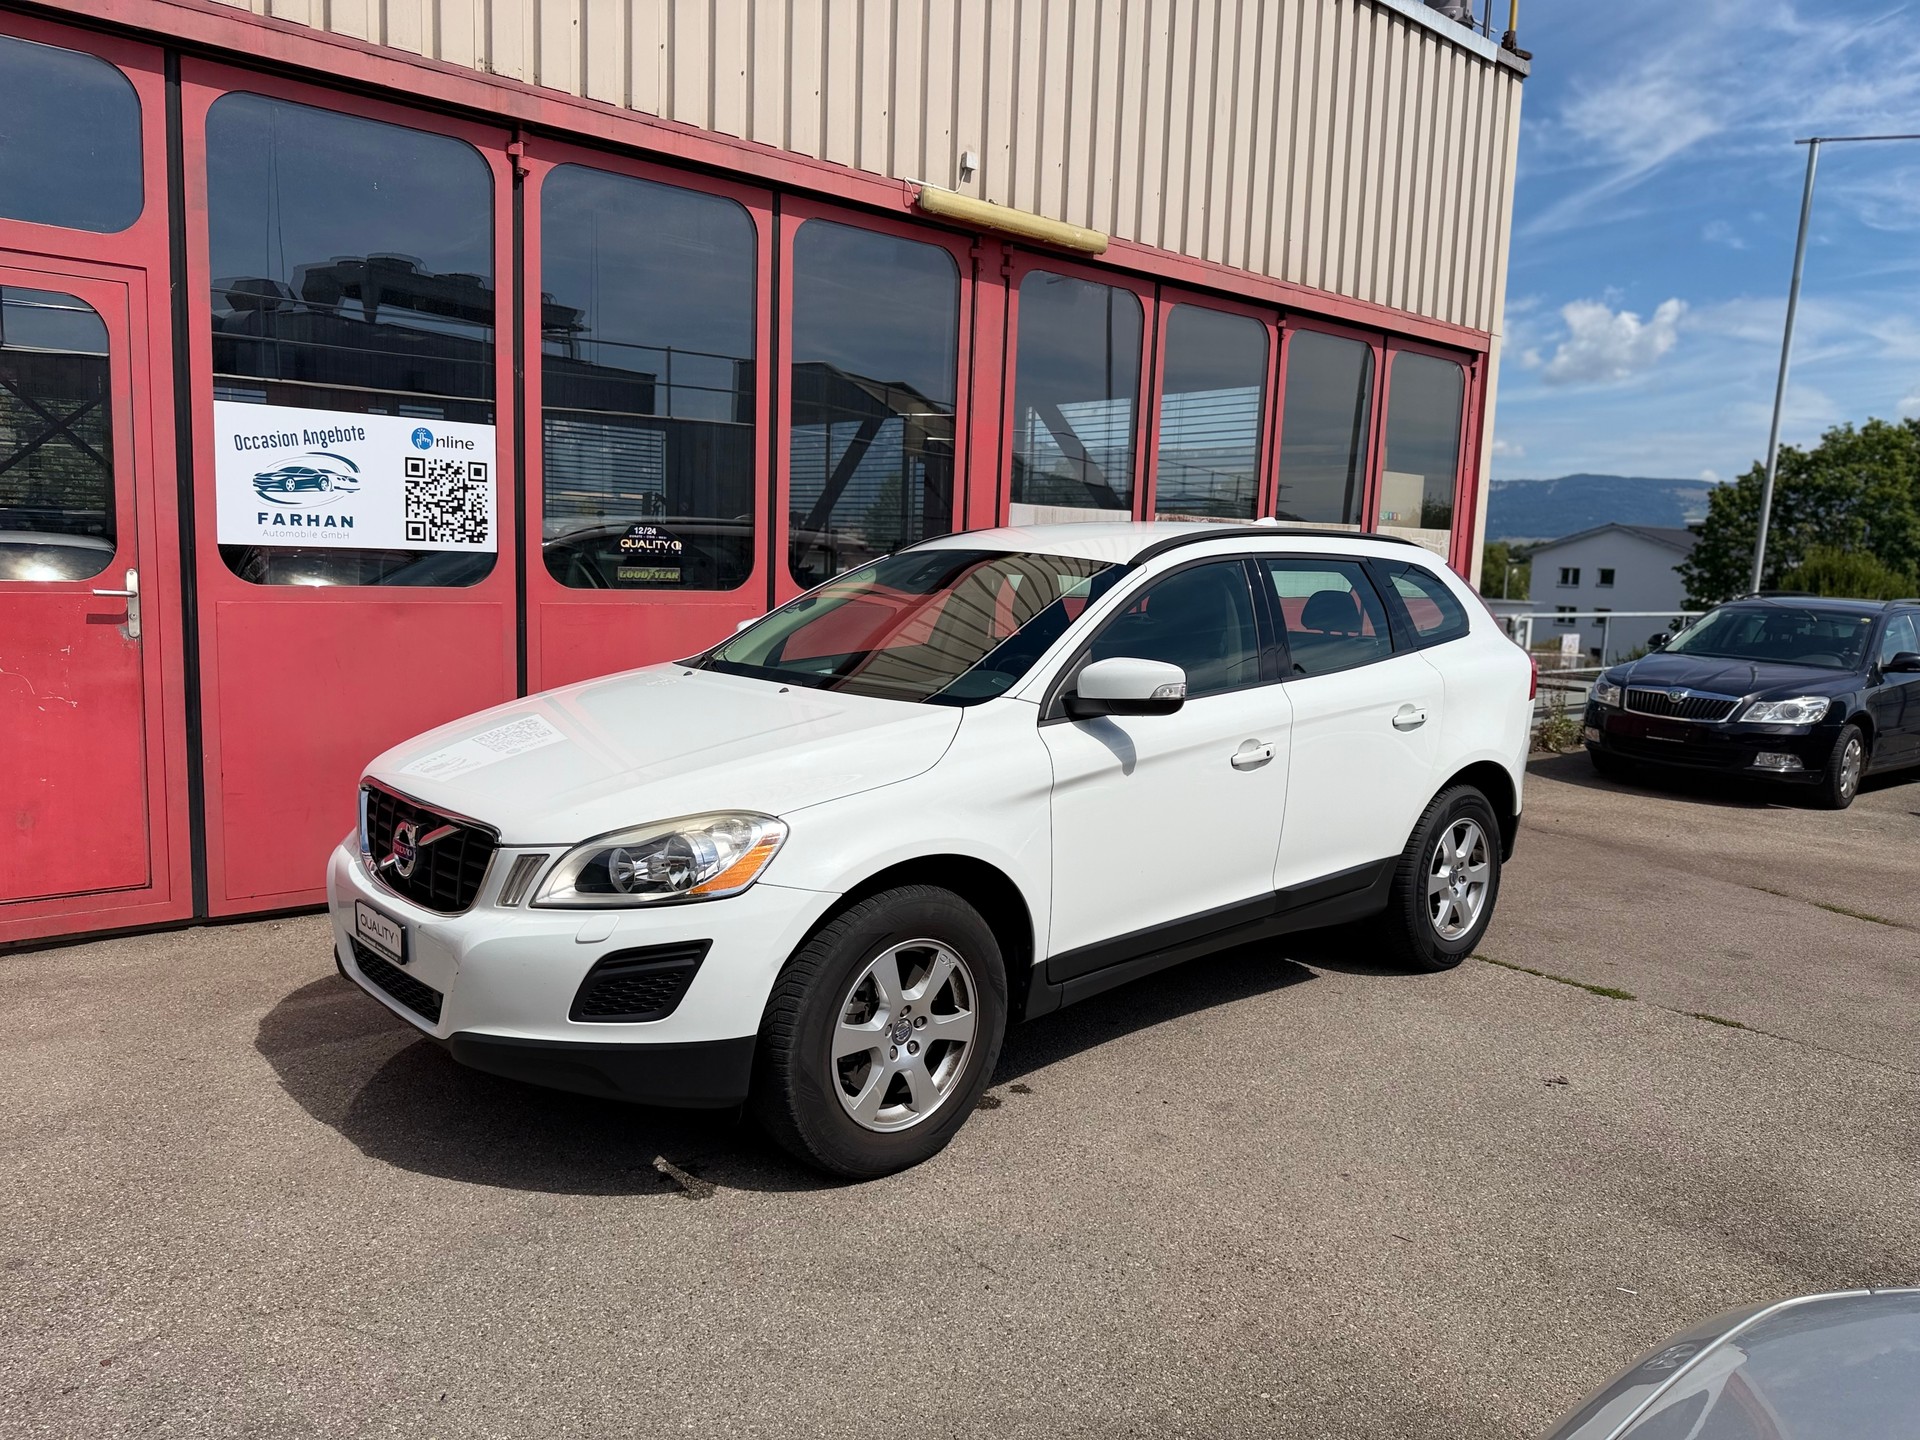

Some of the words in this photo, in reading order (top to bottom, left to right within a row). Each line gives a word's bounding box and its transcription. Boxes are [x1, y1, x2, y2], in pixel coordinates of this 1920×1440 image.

[234, 430, 299, 451] Occasion
[303, 425, 365, 449] Angebote
[257, 512, 354, 528] FARHAN
[262, 529, 318, 539] Automobile
[321, 531, 350, 540] GmbH
[634, 526, 657, 535] 12/24
[619, 568, 679, 580] GOODYEAR
